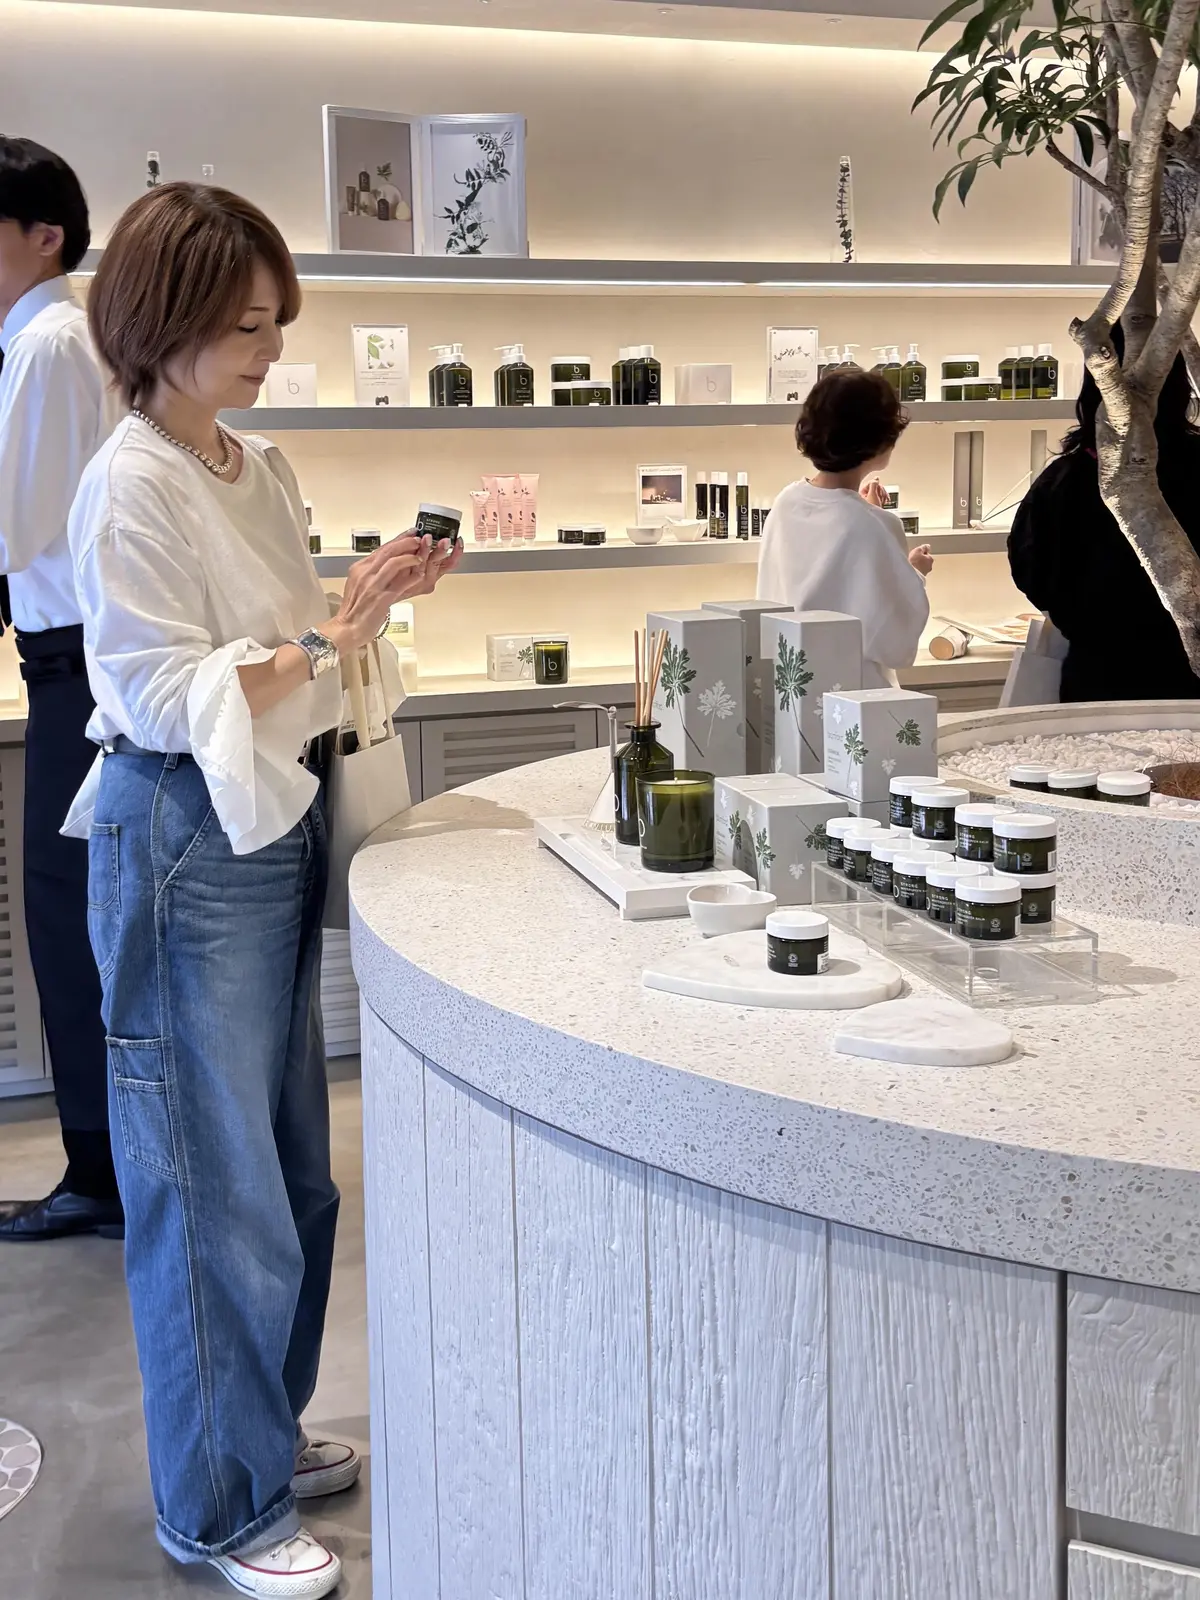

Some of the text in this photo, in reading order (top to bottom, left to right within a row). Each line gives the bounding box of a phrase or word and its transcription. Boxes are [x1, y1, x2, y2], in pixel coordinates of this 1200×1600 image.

[573, 365, 580, 374] b
[1048, 366, 1057, 380] b
[458, 374, 467, 385] b
[520, 374, 528, 386] b
[648, 370, 658, 384] b
[912, 372, 920, 382] b
[287, 378, 300, 394] b
[706, 376, 717, 392] b
[594, 389, 600, 398] b
[960, 497, 968, 508] b
[976, 496, 982, 506] b
[698, 508, 704, 516] b
[740, 505, 748, 514] b
[416, 517, 424, 532] b
[548, 658, 557, 671] b
